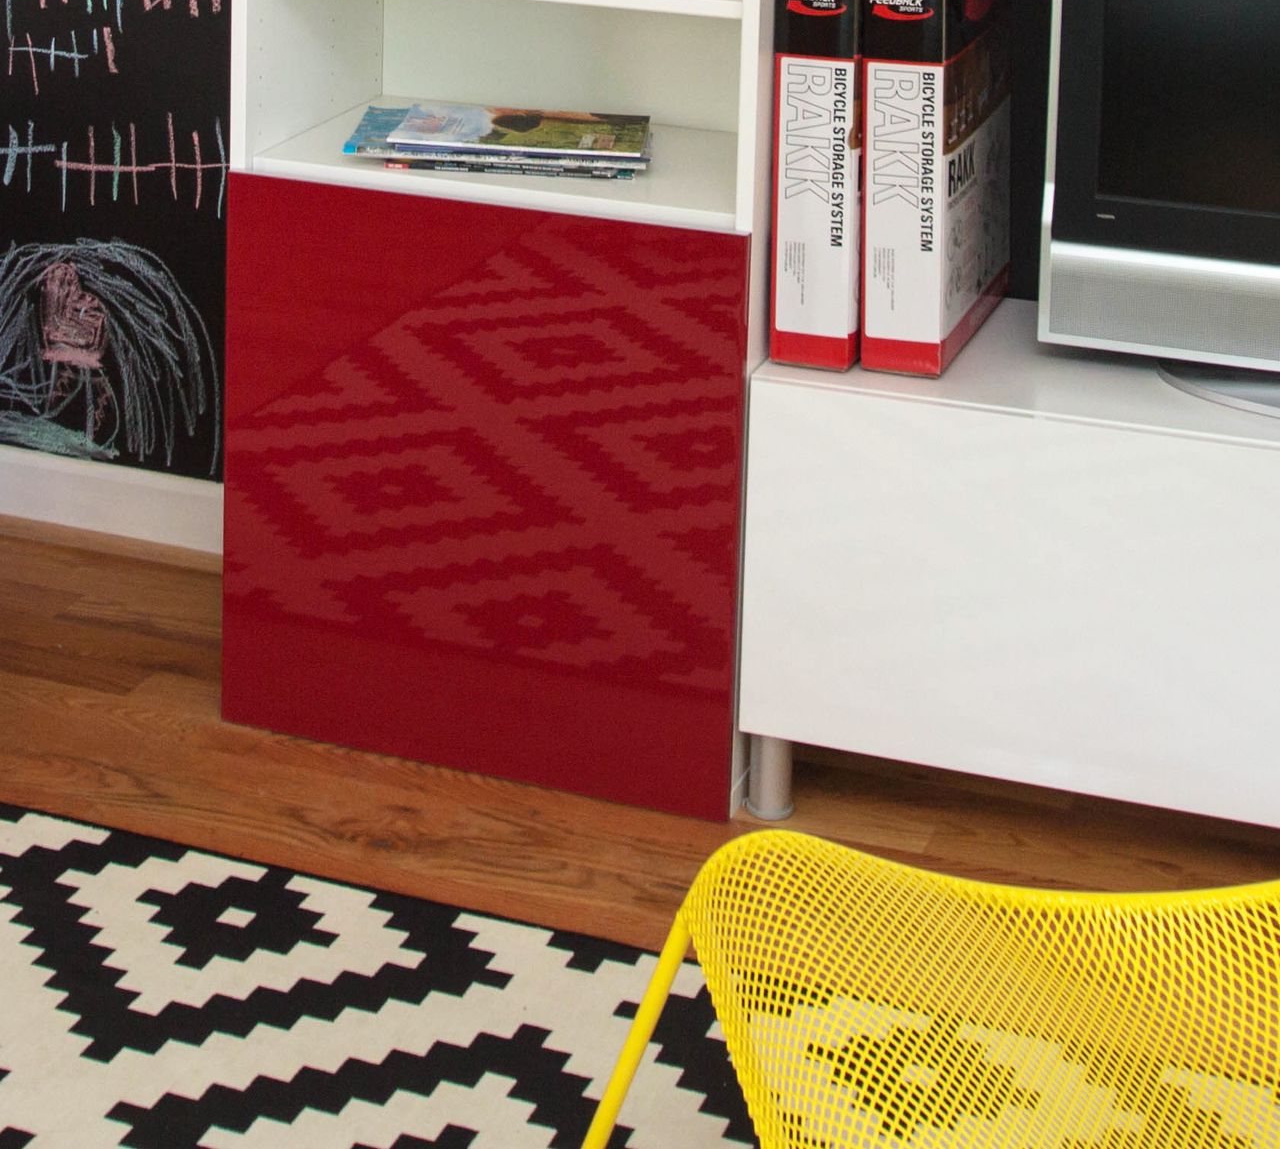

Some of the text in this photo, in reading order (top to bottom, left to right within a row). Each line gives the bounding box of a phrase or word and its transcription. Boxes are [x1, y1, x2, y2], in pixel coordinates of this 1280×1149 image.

[812, 0, 837, 9] SPORTS
[898, 5, 924, 14] SPORTS
[784, 62, 832, 202] RAKK
[830, 67, 847, 248] BICYCLE STORAGE SYSTEM
[872, 67, 922, 210] RAKK
[919, 71, 936, 253] BICYCLE STORAGE SYSTEM
[947, 139, 976, 198] RAKK
